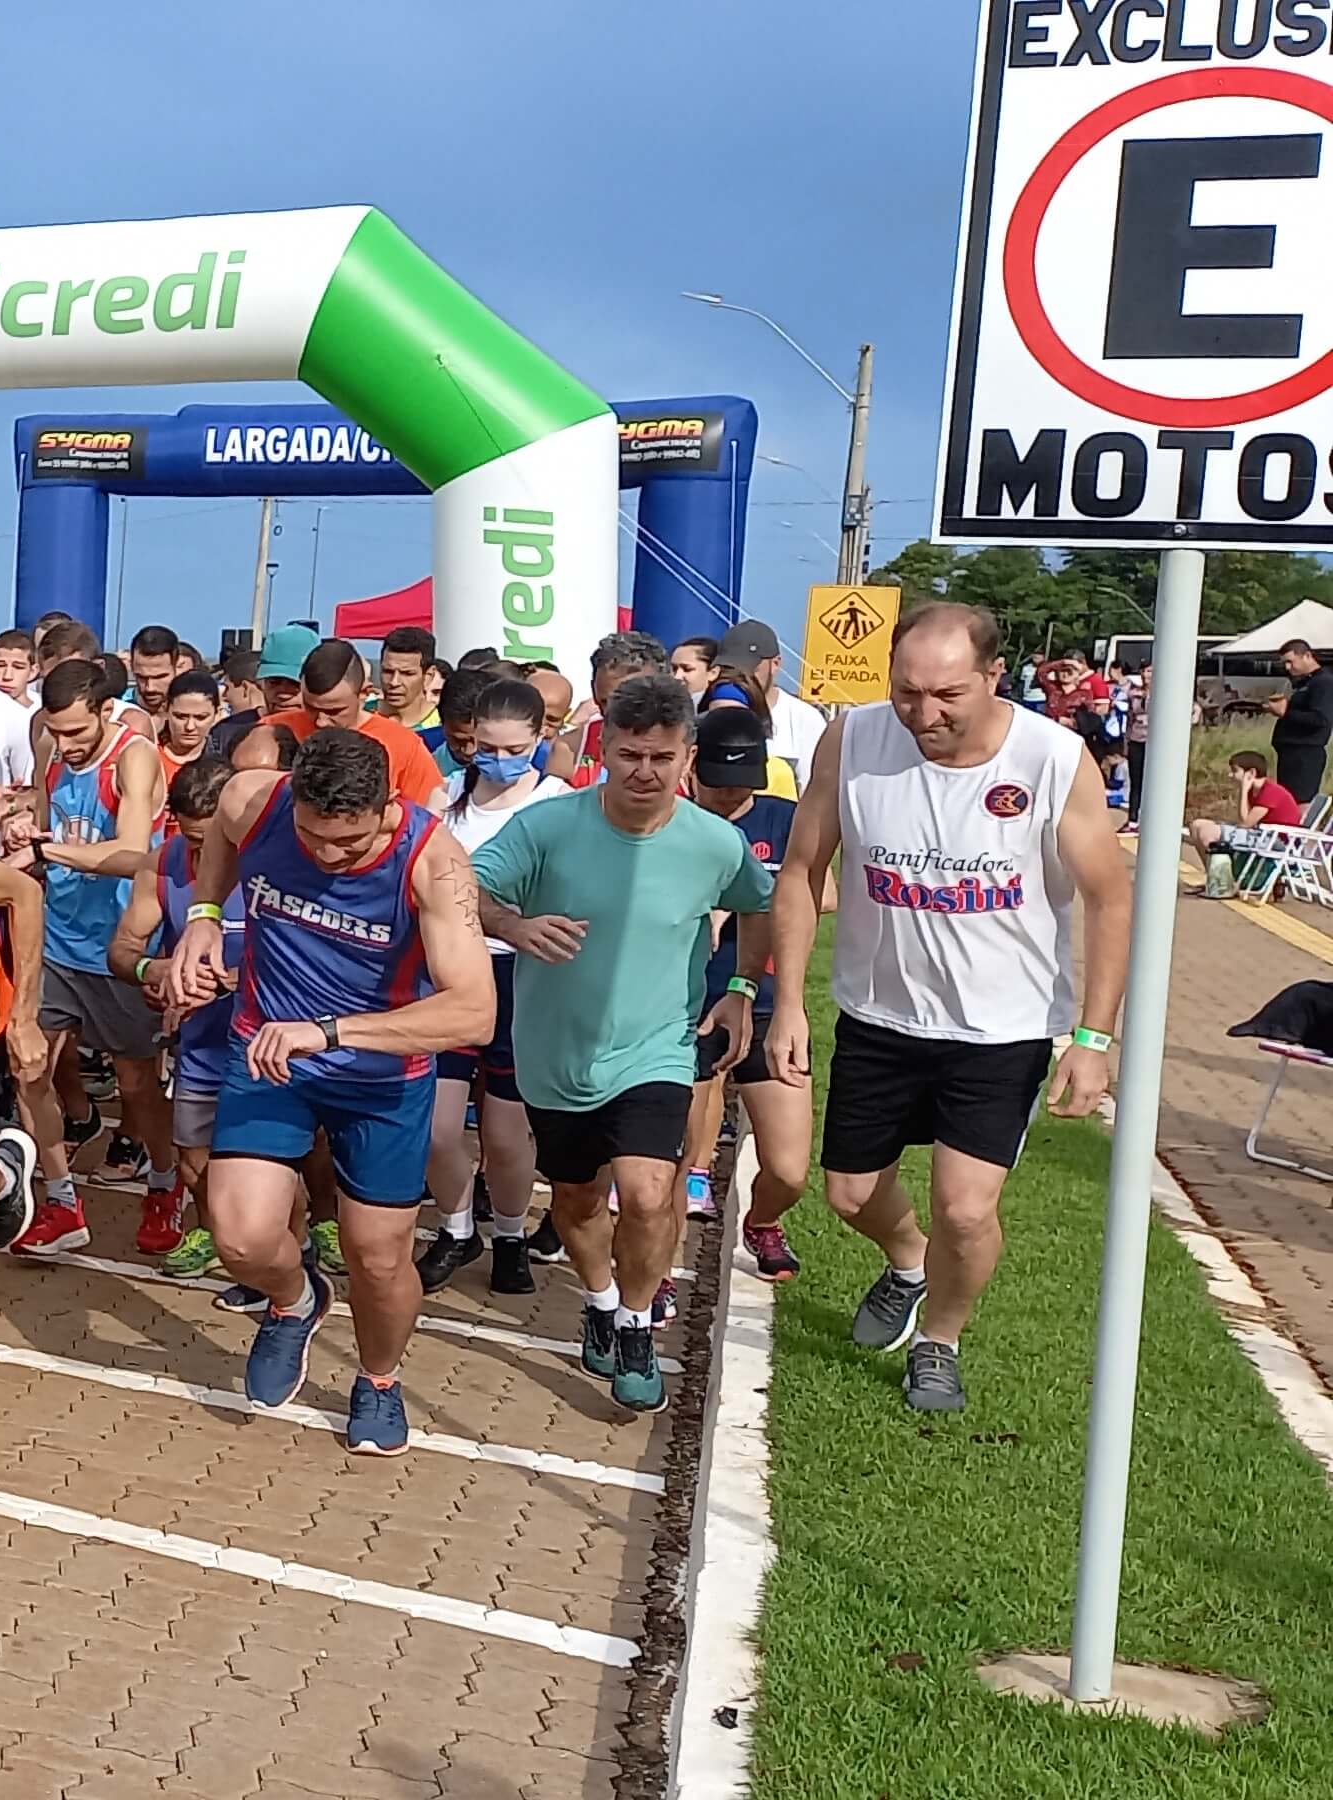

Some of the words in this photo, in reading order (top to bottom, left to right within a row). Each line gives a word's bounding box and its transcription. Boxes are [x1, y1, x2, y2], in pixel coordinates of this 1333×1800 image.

[1008, 0, 1333, 67] EXCLUS
[1104, 133, 1322, 359] E
[38, 432, 132, 449] SYGMA
[205, 426, 391, 463] LARGADA/C
[617, 419, 704, 439] YGMA
[976, 428, 1333, 521] MOTO
[825, 653, 869, 667] FAIXA
